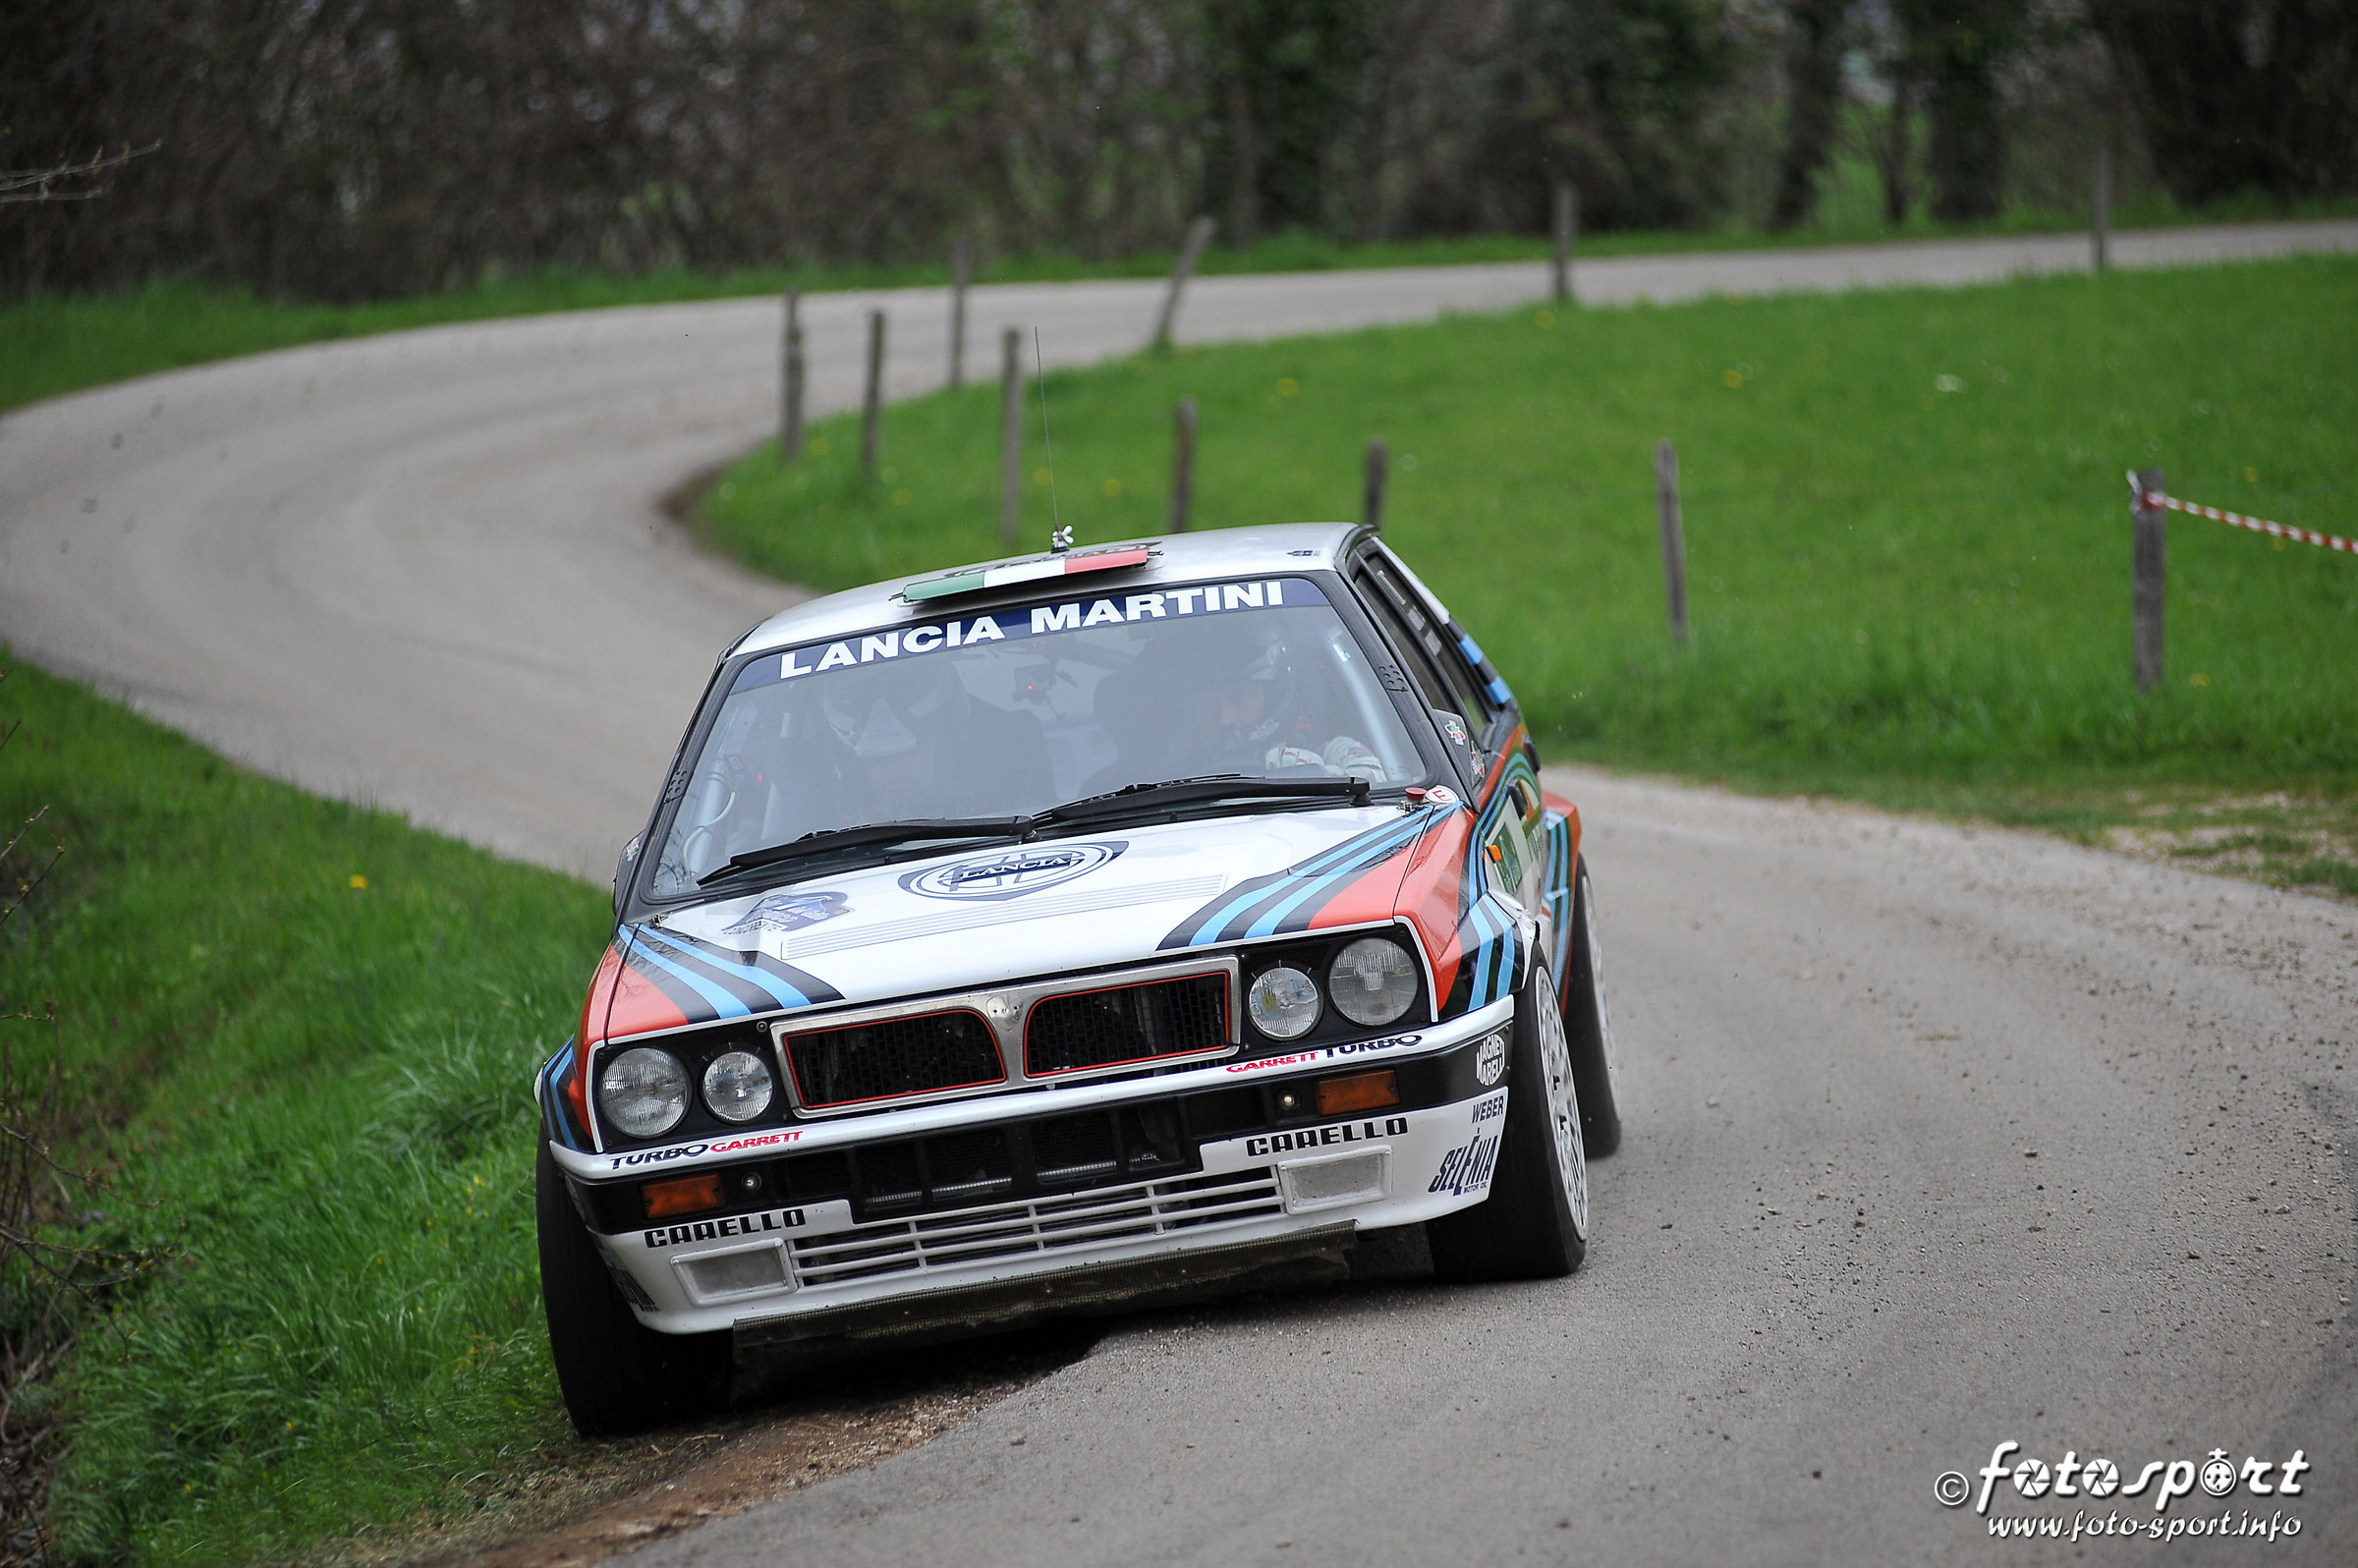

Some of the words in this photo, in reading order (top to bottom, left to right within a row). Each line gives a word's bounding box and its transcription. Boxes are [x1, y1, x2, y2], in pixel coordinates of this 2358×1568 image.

[780, 615, 1006, 681] LANCIA
[1030, 579, 1284, 635] MARTINI
[961, 857, 1068, 879] LANCIA
[1226, 1051, 1319, 1073] GARRETT
[1326, 1035, 1423, 1058] TURBO
[1472, 1094, 1504, 1124] WEBER
[610, 1144, 708, 1170] TURBO
[710, 1131, 803, 1152] GARRETT
[1246, 1117, 1408, 1156] CARELLO
[1428, 1130, 1498, 1196] SELENIA
[644, 1208, 806, 1249] CARELLO
